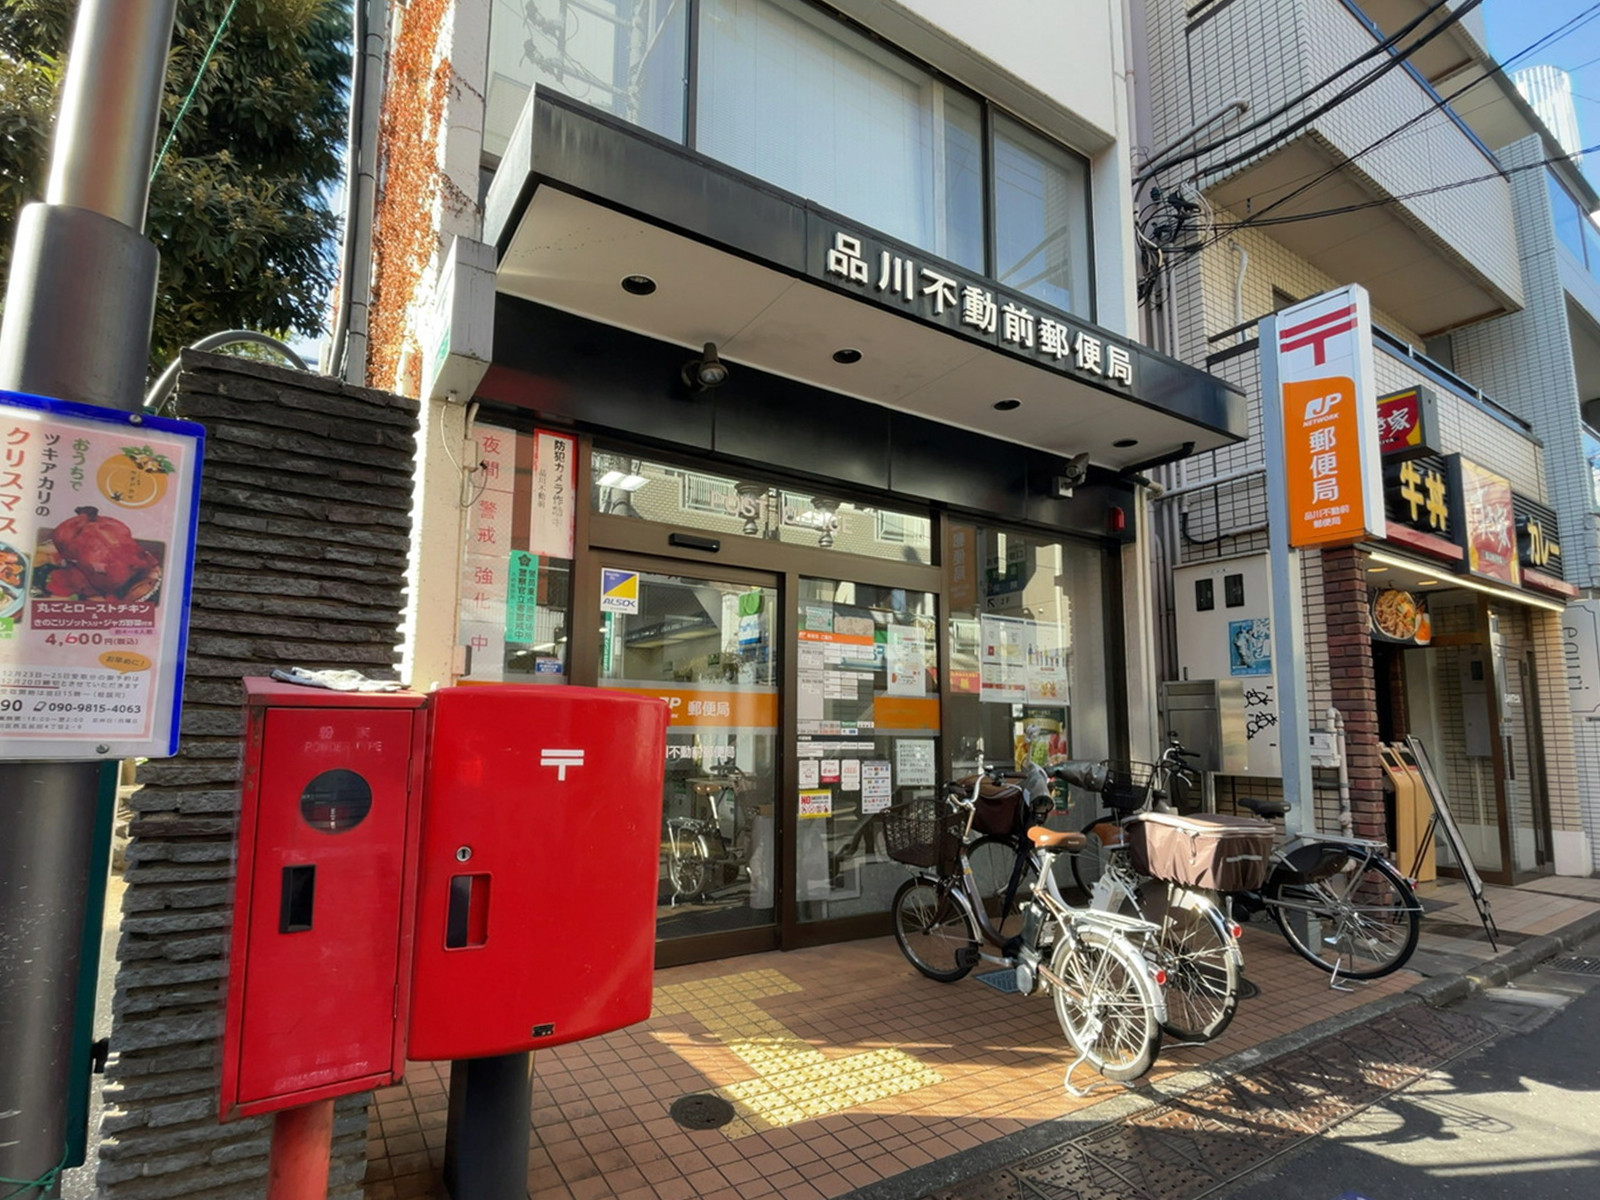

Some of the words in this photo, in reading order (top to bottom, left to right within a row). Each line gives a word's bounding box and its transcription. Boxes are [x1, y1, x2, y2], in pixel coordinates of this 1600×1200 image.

[827, 232, 1133, 386] 品川不動前郵便局
[1303, 413, 1340, 428] NETWORK
[1305, 392, 1342, 420] JP
[0, 426, 31, 534] クリスマス
[35, 433, 61, 517] ツキアカリの
[1309, 426, 1339, 504] 郵便局
[1400, 459, 1448, 531] 牛丼
[471, 435, 502, 652] 夜間警戒強化中
[1527, 515, 1560, 566] カレー
[37, 602, 150, 614] 丸ごとローストチキン
[603, 597, 636, 608] ALSOK
[48, 702, 142, 714] 090-9815-4063
[688, 701, 730, 718] 郵便局
[801, 795, 811, 805] NO
